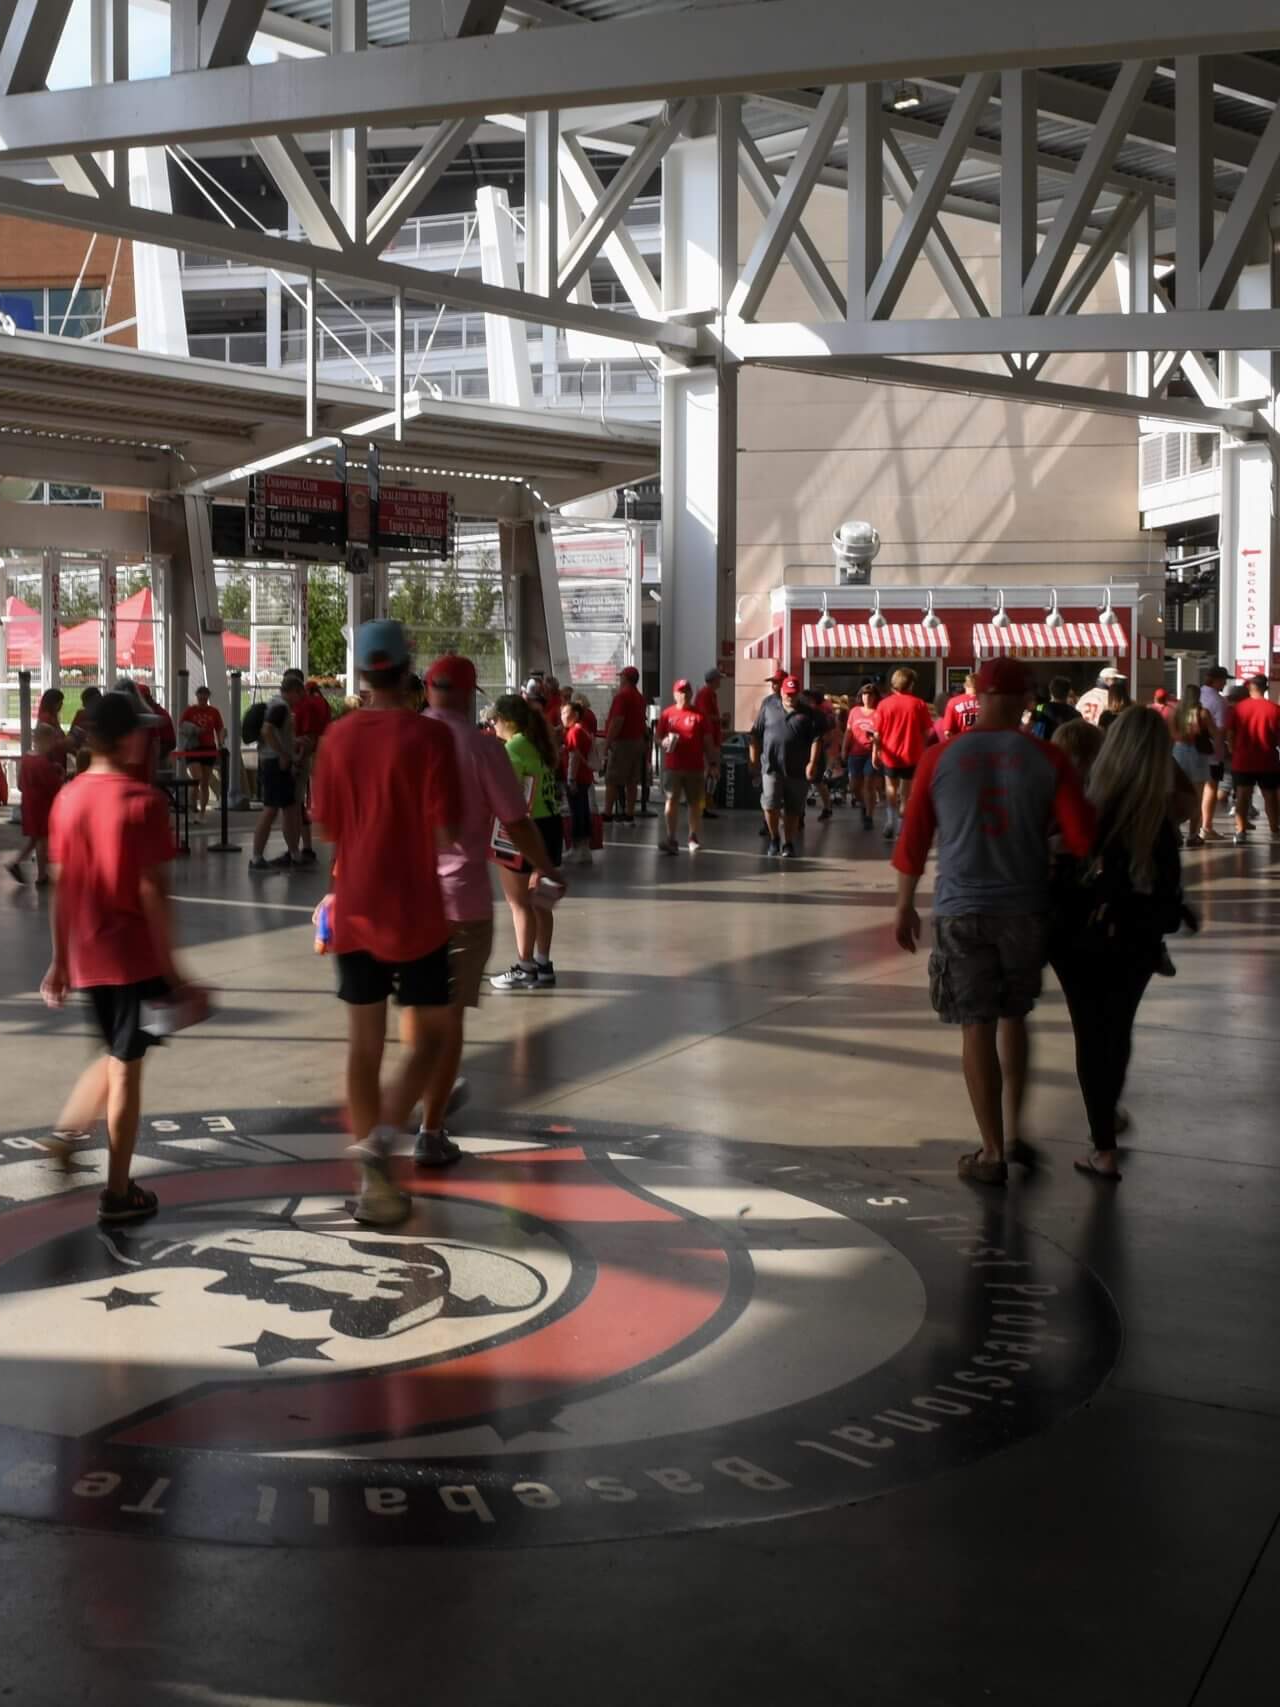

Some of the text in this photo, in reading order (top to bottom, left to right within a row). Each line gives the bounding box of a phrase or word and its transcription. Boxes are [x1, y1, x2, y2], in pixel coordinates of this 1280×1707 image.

[726, 760, 736, 808] RECYCLE
[793, 1282, 1070, 1470] Professional
[254, 1454, 795, 1527] Baseball
